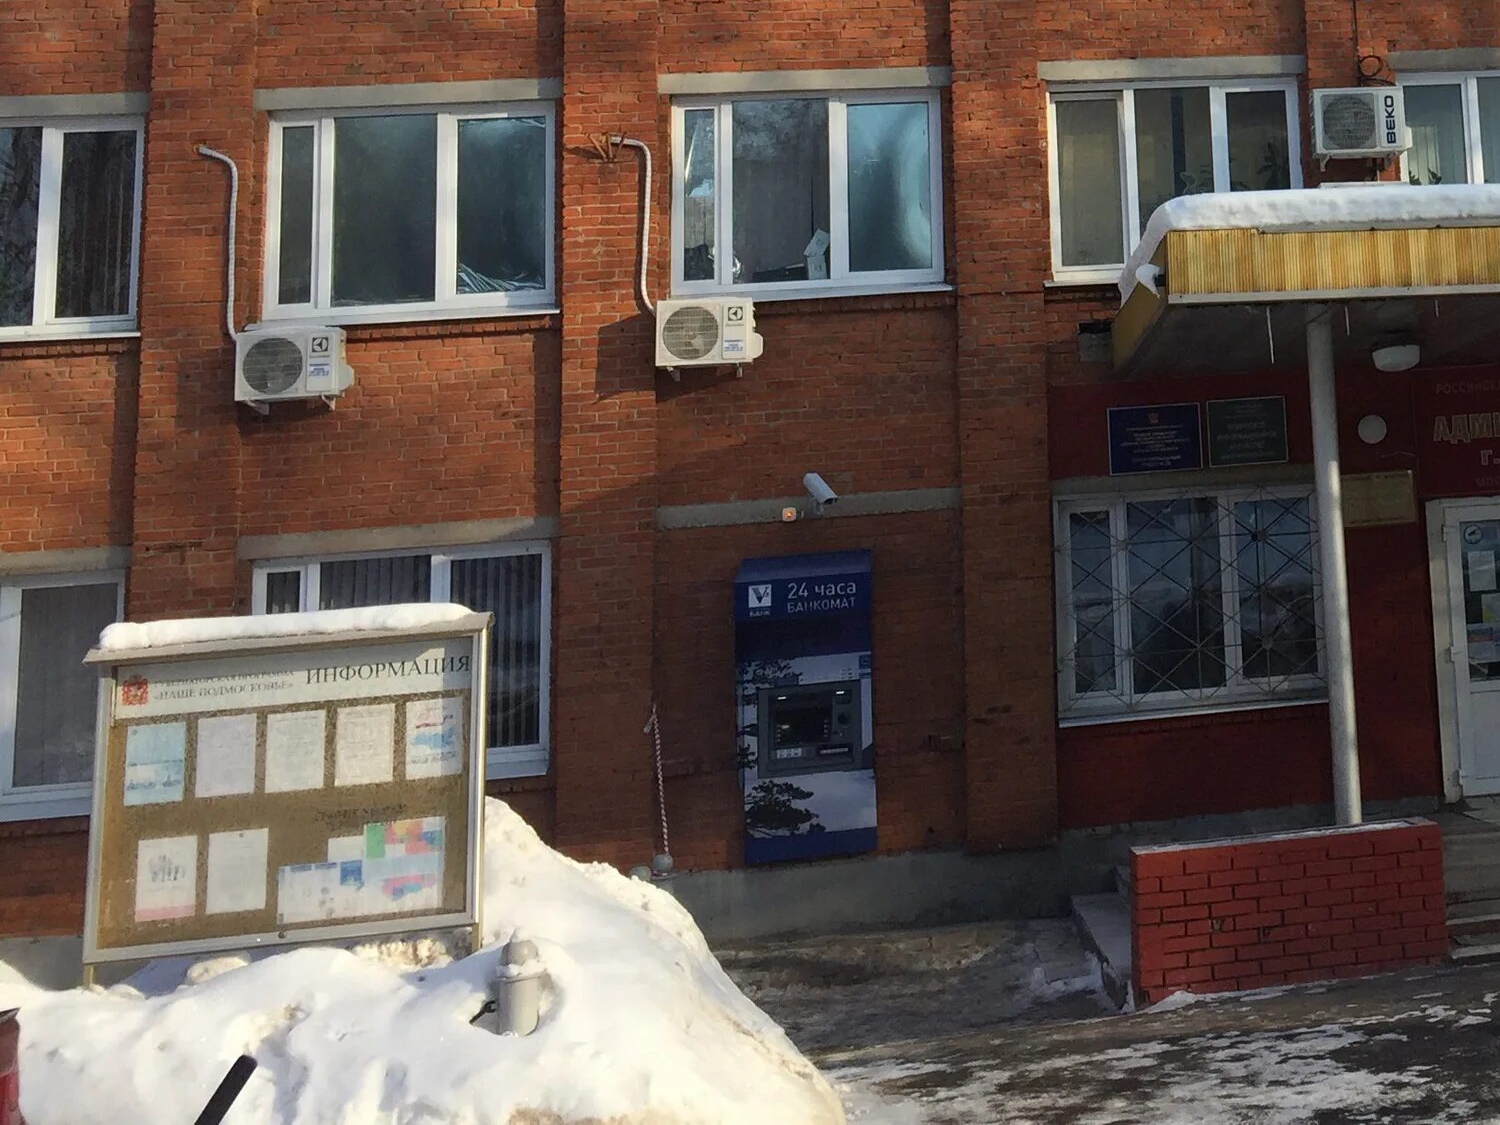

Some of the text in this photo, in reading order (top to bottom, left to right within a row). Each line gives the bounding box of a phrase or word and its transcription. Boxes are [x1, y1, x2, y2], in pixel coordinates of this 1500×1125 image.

[1384, 95, 1397, 144] BEKO
[1480, 448, 1500, 466] г.
[787, 581, 857, 599] 24 часа
[787, 597, 857, 613] БАНКОМАТ
[305, 655, 470, 684] ИНФОРМАЦИЯ
